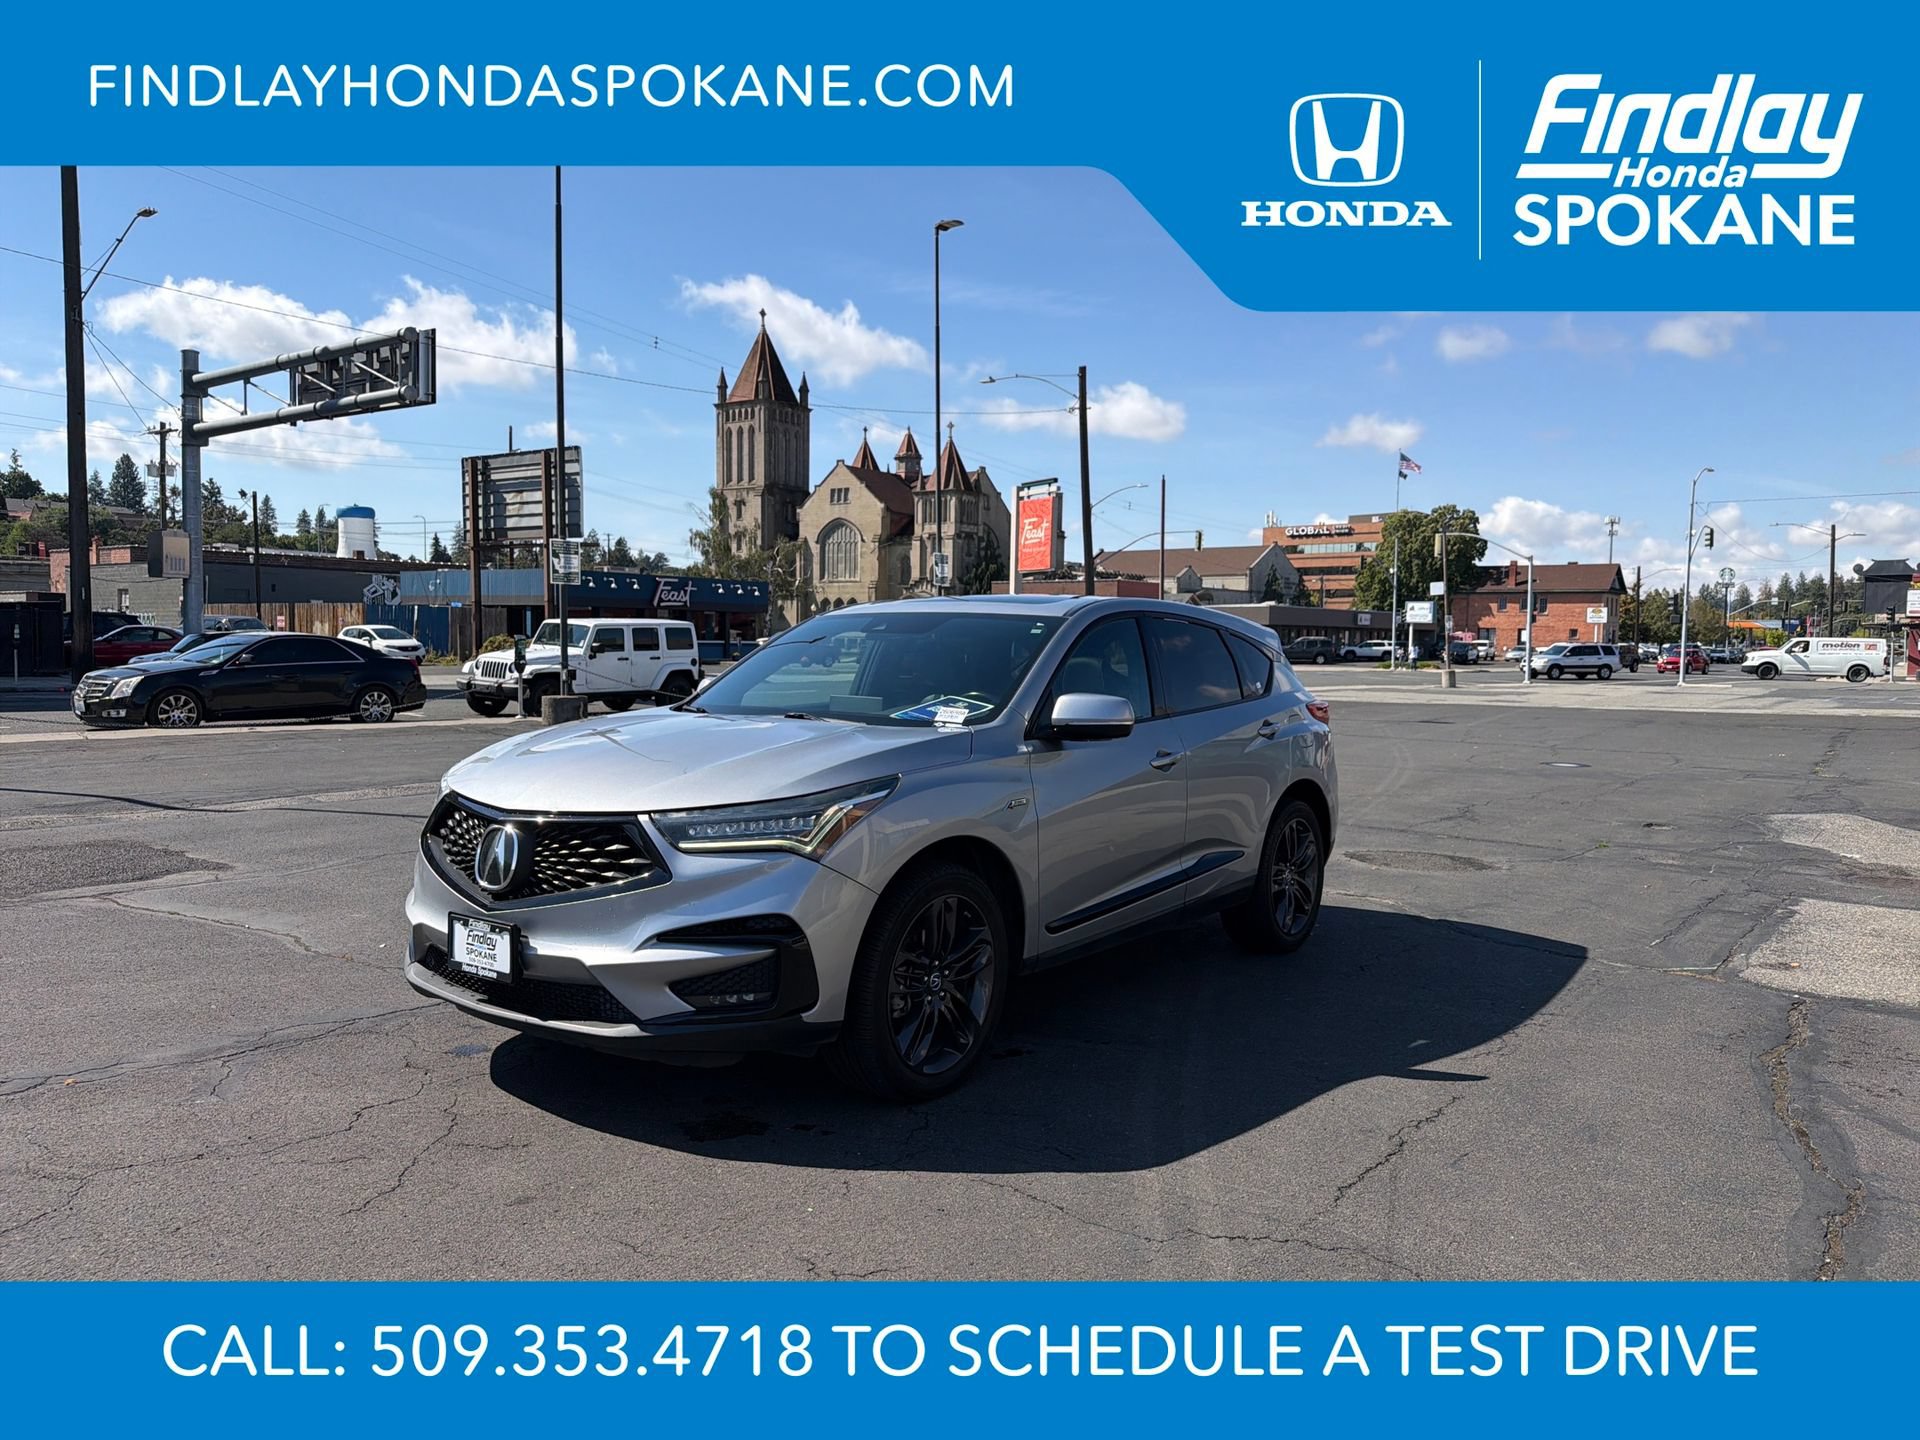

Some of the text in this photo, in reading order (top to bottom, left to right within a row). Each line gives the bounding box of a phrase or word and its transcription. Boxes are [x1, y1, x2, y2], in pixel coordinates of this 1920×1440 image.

[1021, 518, 1050, 545] Feast
[1285, 525, 1329, 536] GLOBAL
[653, 577, 698, 608] Feast
[1821, 641, 1861, 649] motion
[466, 930, 498, 951] Findlay
[465, 947, 498, 962] SPOKANE
